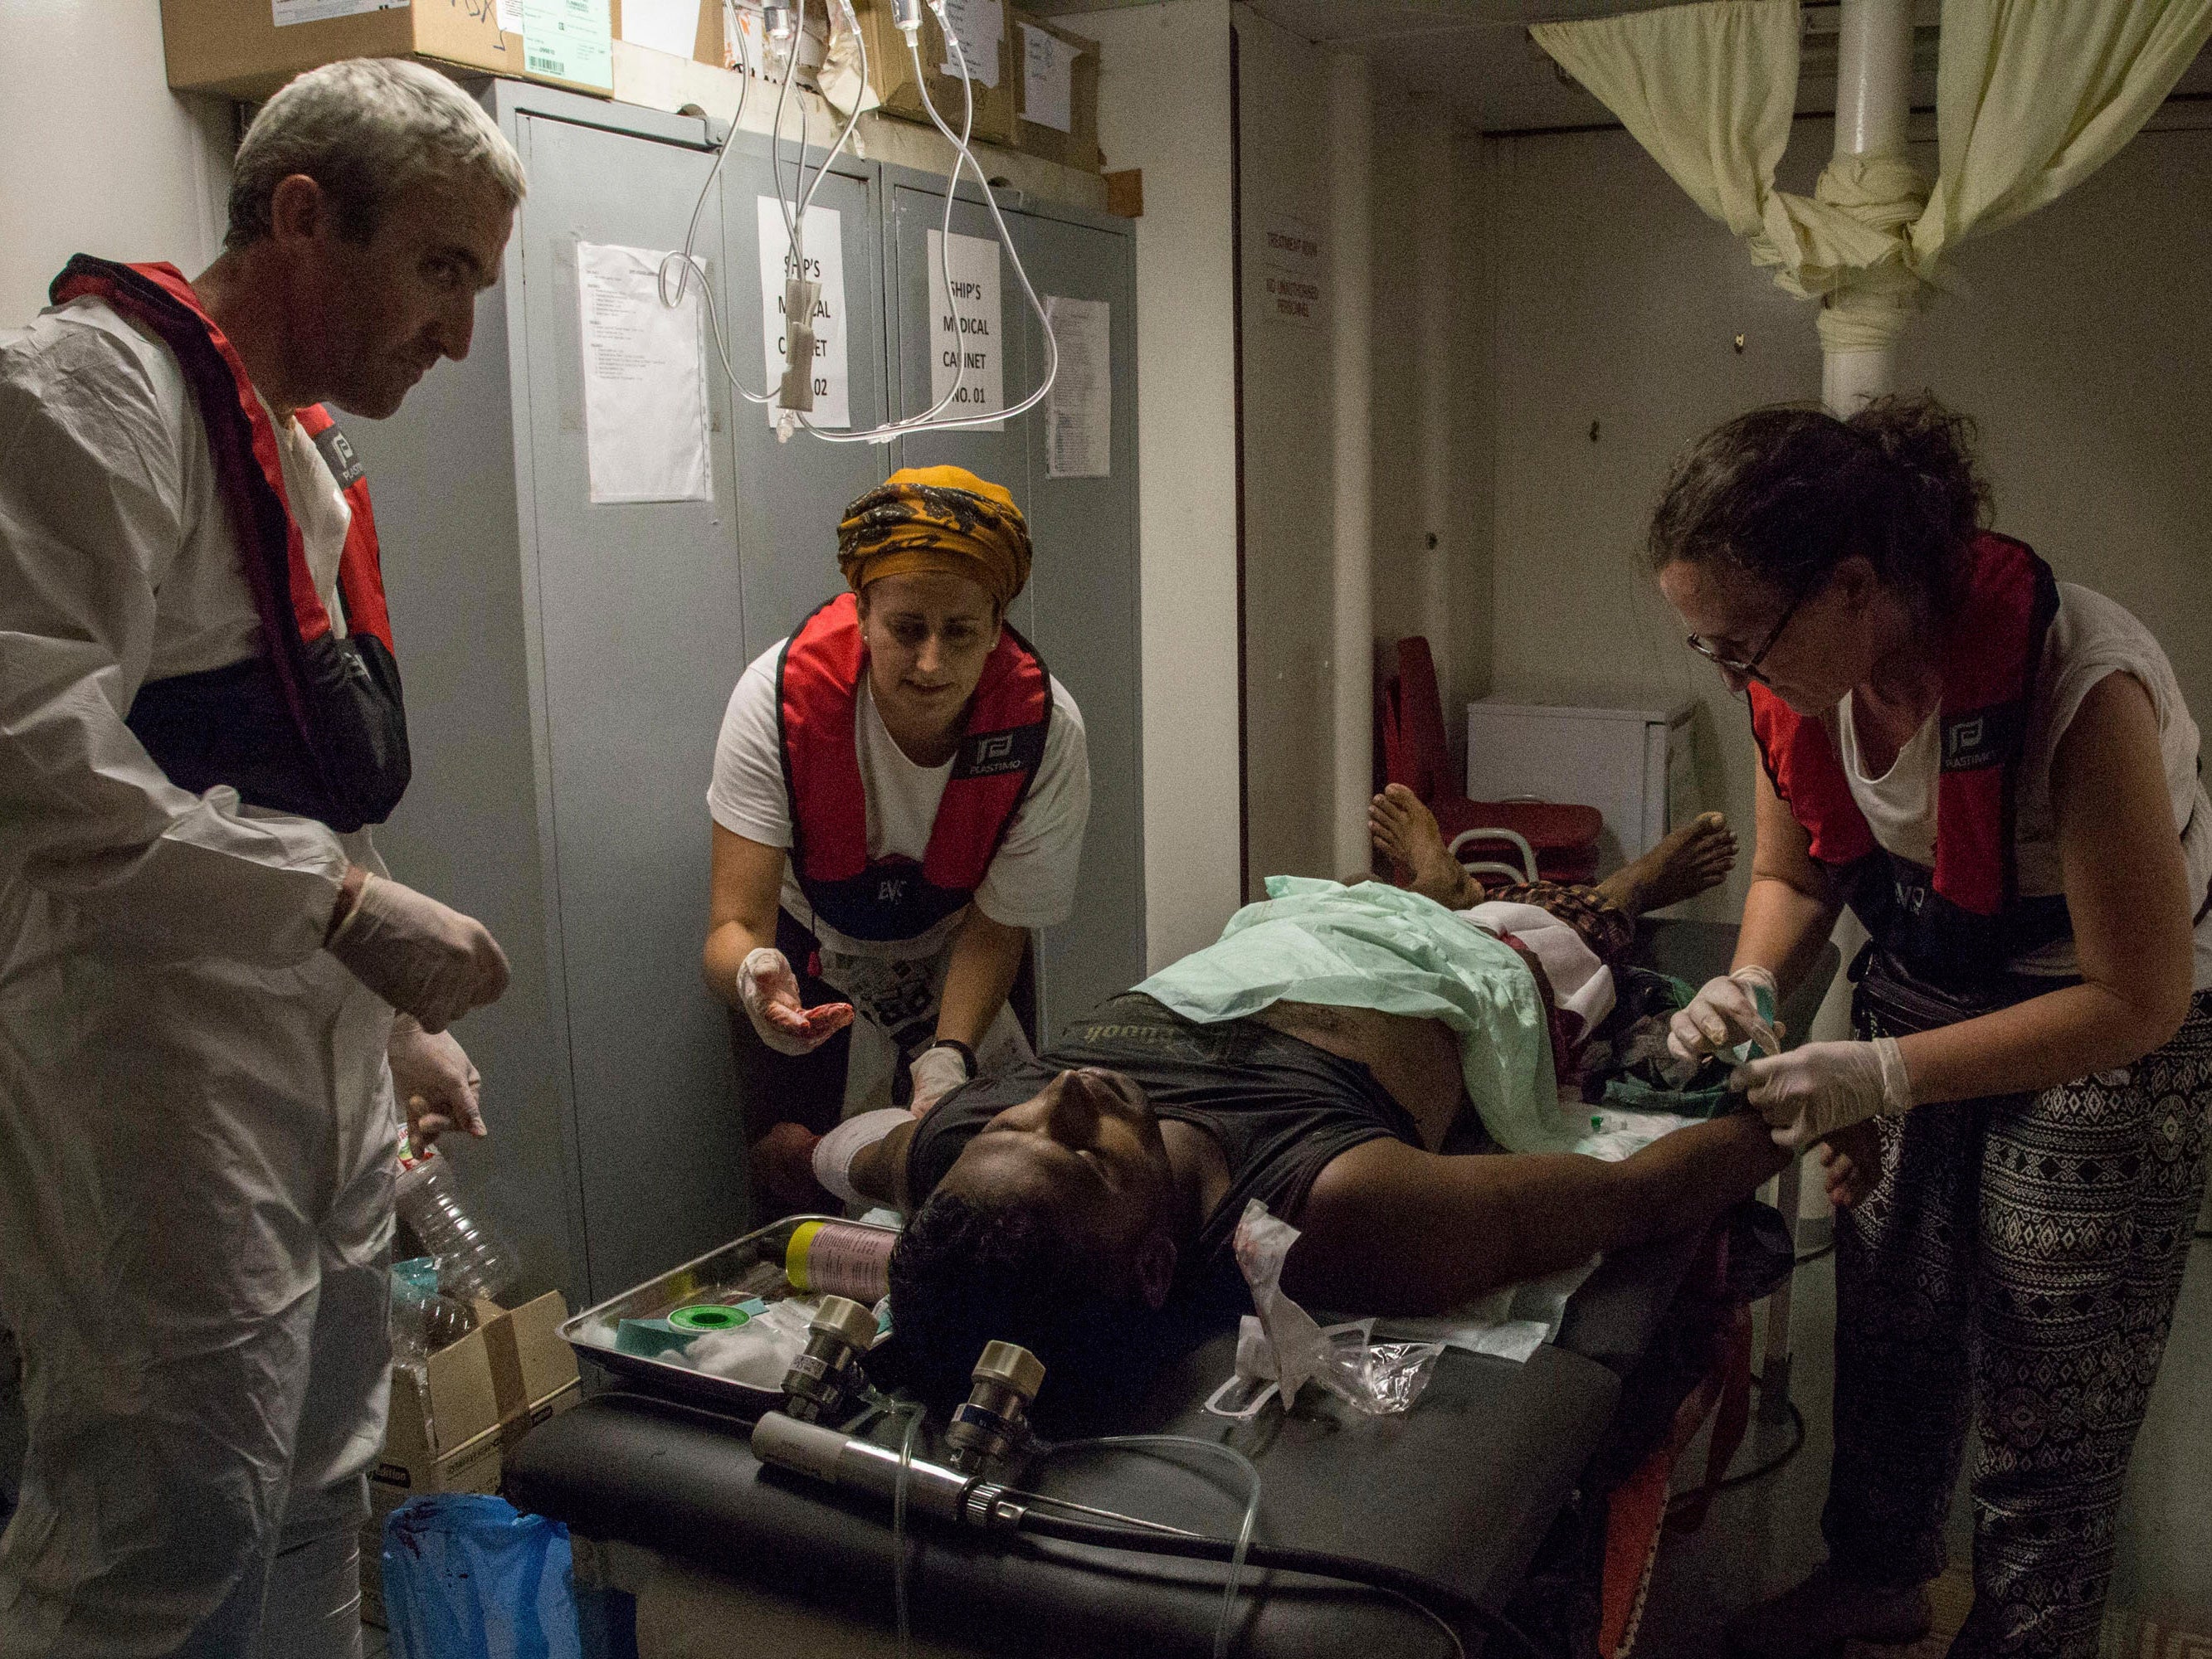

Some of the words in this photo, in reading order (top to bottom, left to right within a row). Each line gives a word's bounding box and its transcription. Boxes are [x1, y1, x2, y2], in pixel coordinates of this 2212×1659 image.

[950, 280, 982, 299] SHIP'S
[943, 315, 989, 335] MDICAL
[943, 351, 987, 370] CAINET
[814, 378, 827, 396] 02
[952, 387, 971, 403] NO.
[973, 387, 986, 403] 01
[969, 759, 1021, 775] PLASTIMO
